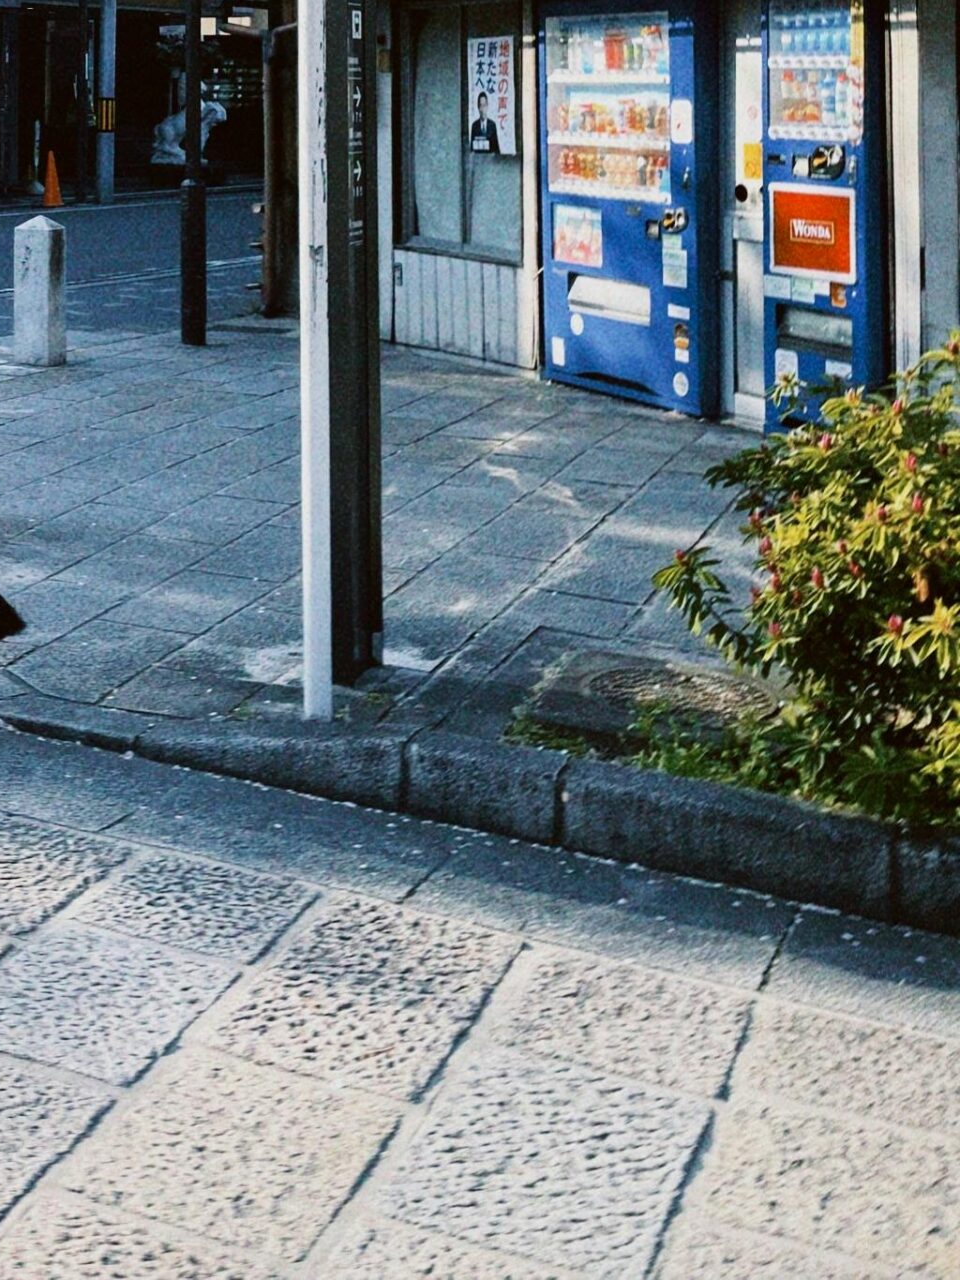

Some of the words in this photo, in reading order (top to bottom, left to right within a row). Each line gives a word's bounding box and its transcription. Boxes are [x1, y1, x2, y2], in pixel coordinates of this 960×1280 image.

[475, 42, 486, 89] 日本へ
[486, 41, 498, 94] 新たな
[792, 219, 831, 240] WONDA
